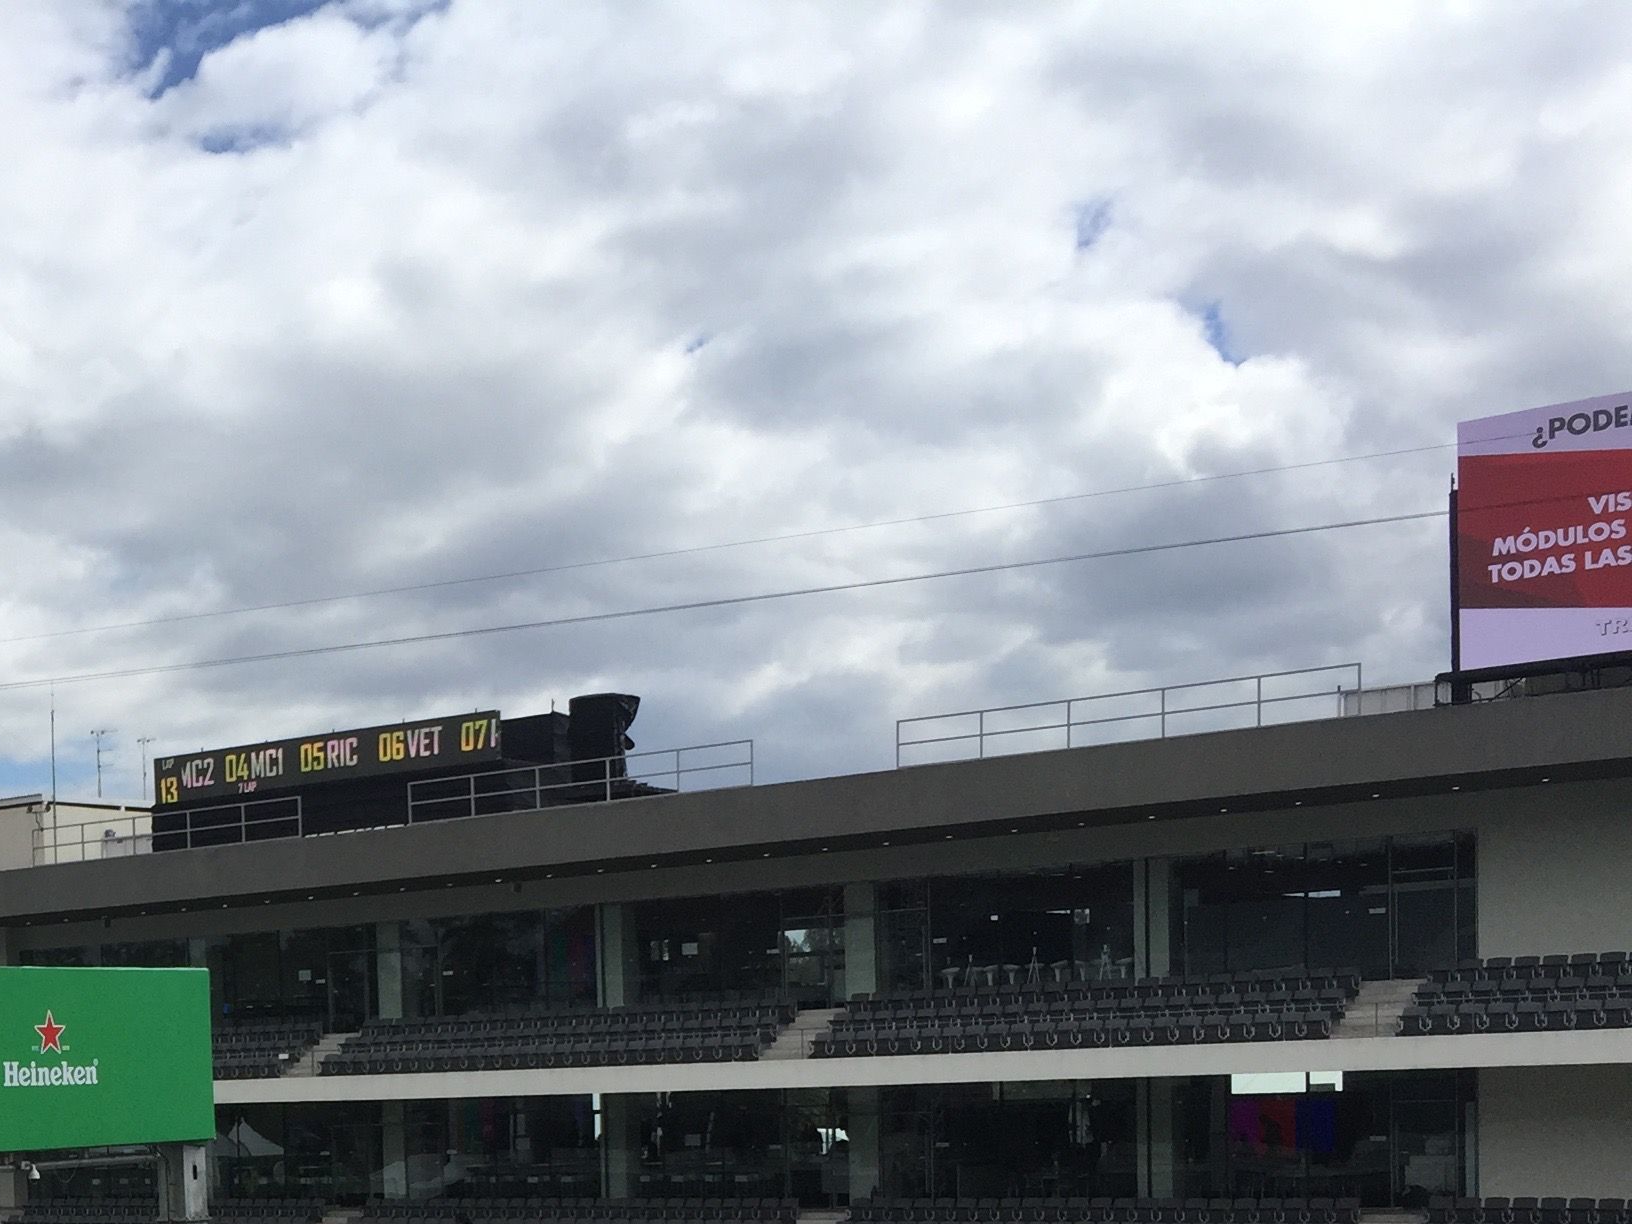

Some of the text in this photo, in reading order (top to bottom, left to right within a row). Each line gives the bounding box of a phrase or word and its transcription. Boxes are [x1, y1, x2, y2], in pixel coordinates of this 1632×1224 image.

[1532, 404, 1632, 449] ¿PODE
[1492, 519, 1626, 557] MÓDULOS
[1488, 545, 1632, 583] TODAS LAS
[160, 776, 179, 804] 13
